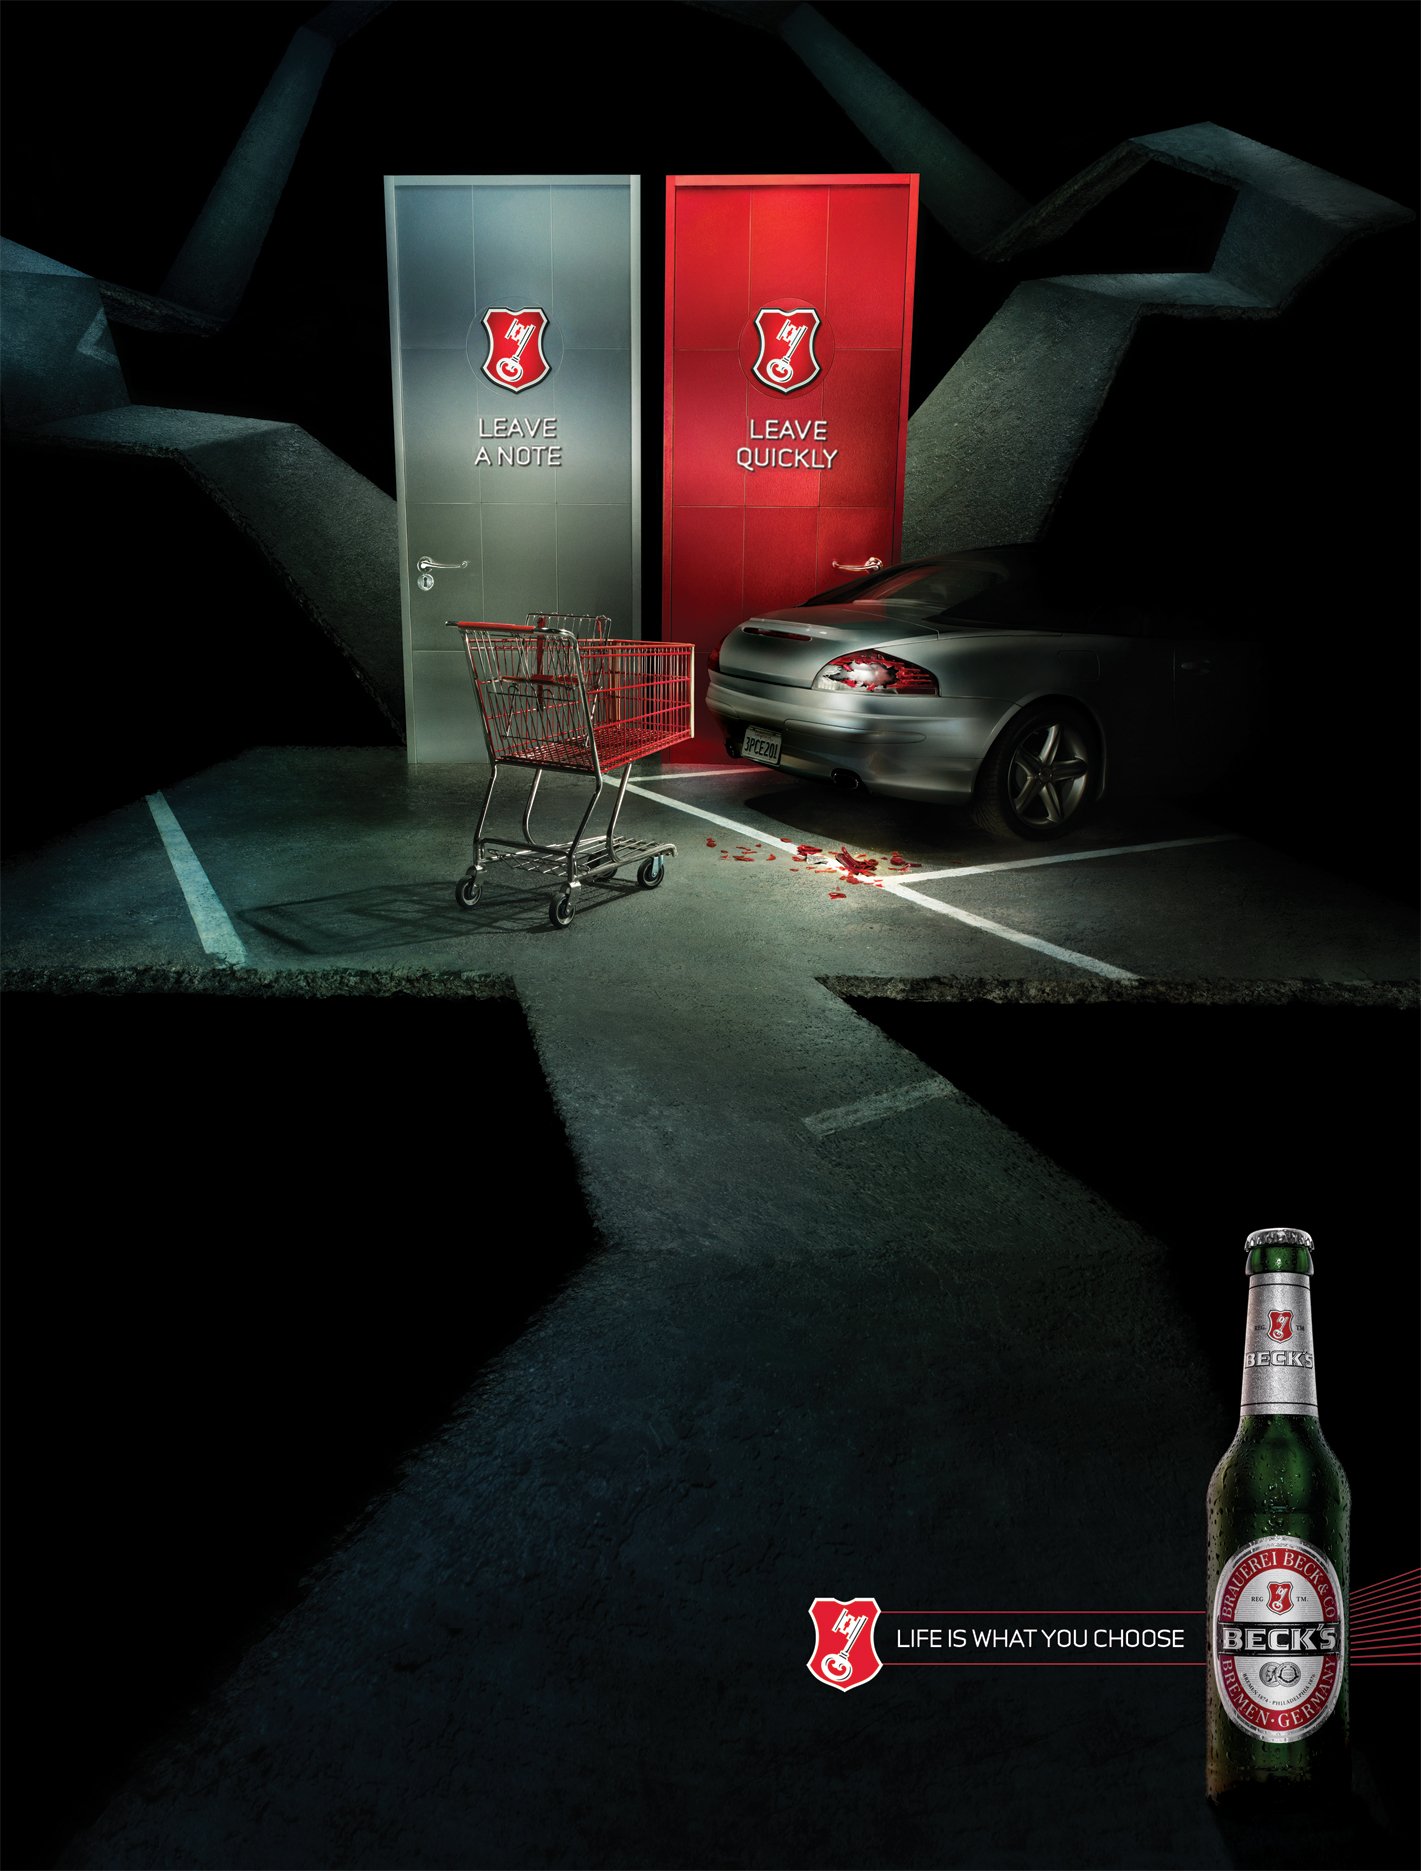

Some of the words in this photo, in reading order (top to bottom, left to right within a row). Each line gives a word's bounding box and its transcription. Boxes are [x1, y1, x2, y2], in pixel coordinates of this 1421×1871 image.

[478, 417, 558, 439] LEAVE
[749, 419, 828, 441] LEAVE
[475, 446, 492, 466] A
[498, 446, 562, 467] NOTE
[736, 447, 839, 471] QUICKLY
[1244, 1350, 1314, 1369] BECK'S
[1221, 1551, 1278, 1619] BRAUEREI
[1283, 1551, 1324, 1585] BECK
[1317, 1583, 1329, 1595] &
[1323, 1596, 1337, 1618] CO
[1222, 1624, 1337, 1651] BECK'S
[1222, 1659, 1269, 1726] BREMEN
[1278, 1658, 1336, 1728] GERMANY
